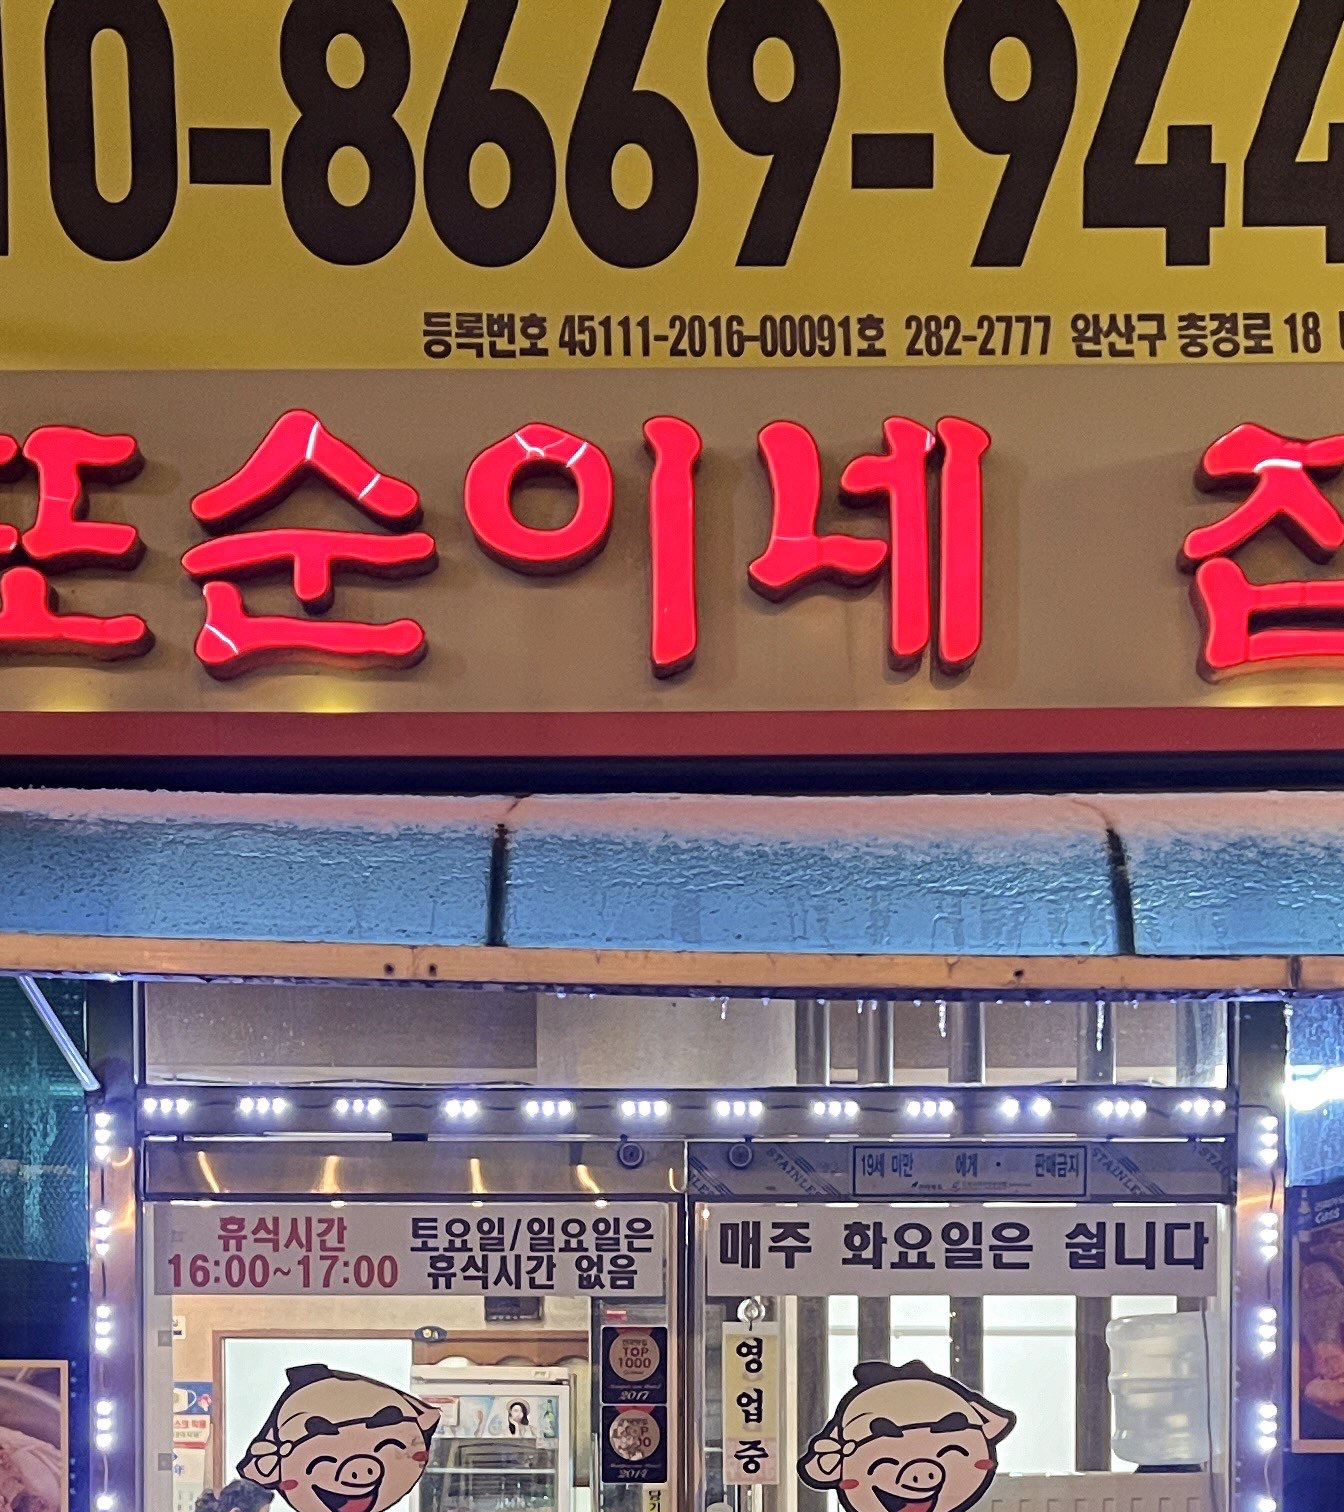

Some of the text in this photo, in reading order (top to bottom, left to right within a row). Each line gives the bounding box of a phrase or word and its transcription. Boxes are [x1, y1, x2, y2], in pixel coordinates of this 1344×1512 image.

[422, 312, 549, 358] 등록번호
[558, 313, 888, 359] 45111-2016-00091호
[905, 314, 1052, 358] 282-2777
[1070, 313, 1168, 359] 완산구
[1177, 311, 1274, 357] 충경로
[1284, 312, 1322, 355] 18
[860, 1153, 884, 1178] 19세
[891, 1154, 913, 1178] 미만
[217, 1216, 347, 1253] 휴식시간
[410, 1216, 654, 1253] 토요일/일요일은
[719, 1220, 1209, 1270] 매주 화요일은 쉽니다
[167, 1254, 399, 1289] 16:00~17:00
[426, 1254, 638, 1290] 휴식시간 없음
[618, 1357, 651, 1368] 1000
[623, 1347, 649, 1357] TOP
[619, 1391, 650, 1400] 2017
[733, 1336, 769, 1474] 영업중
